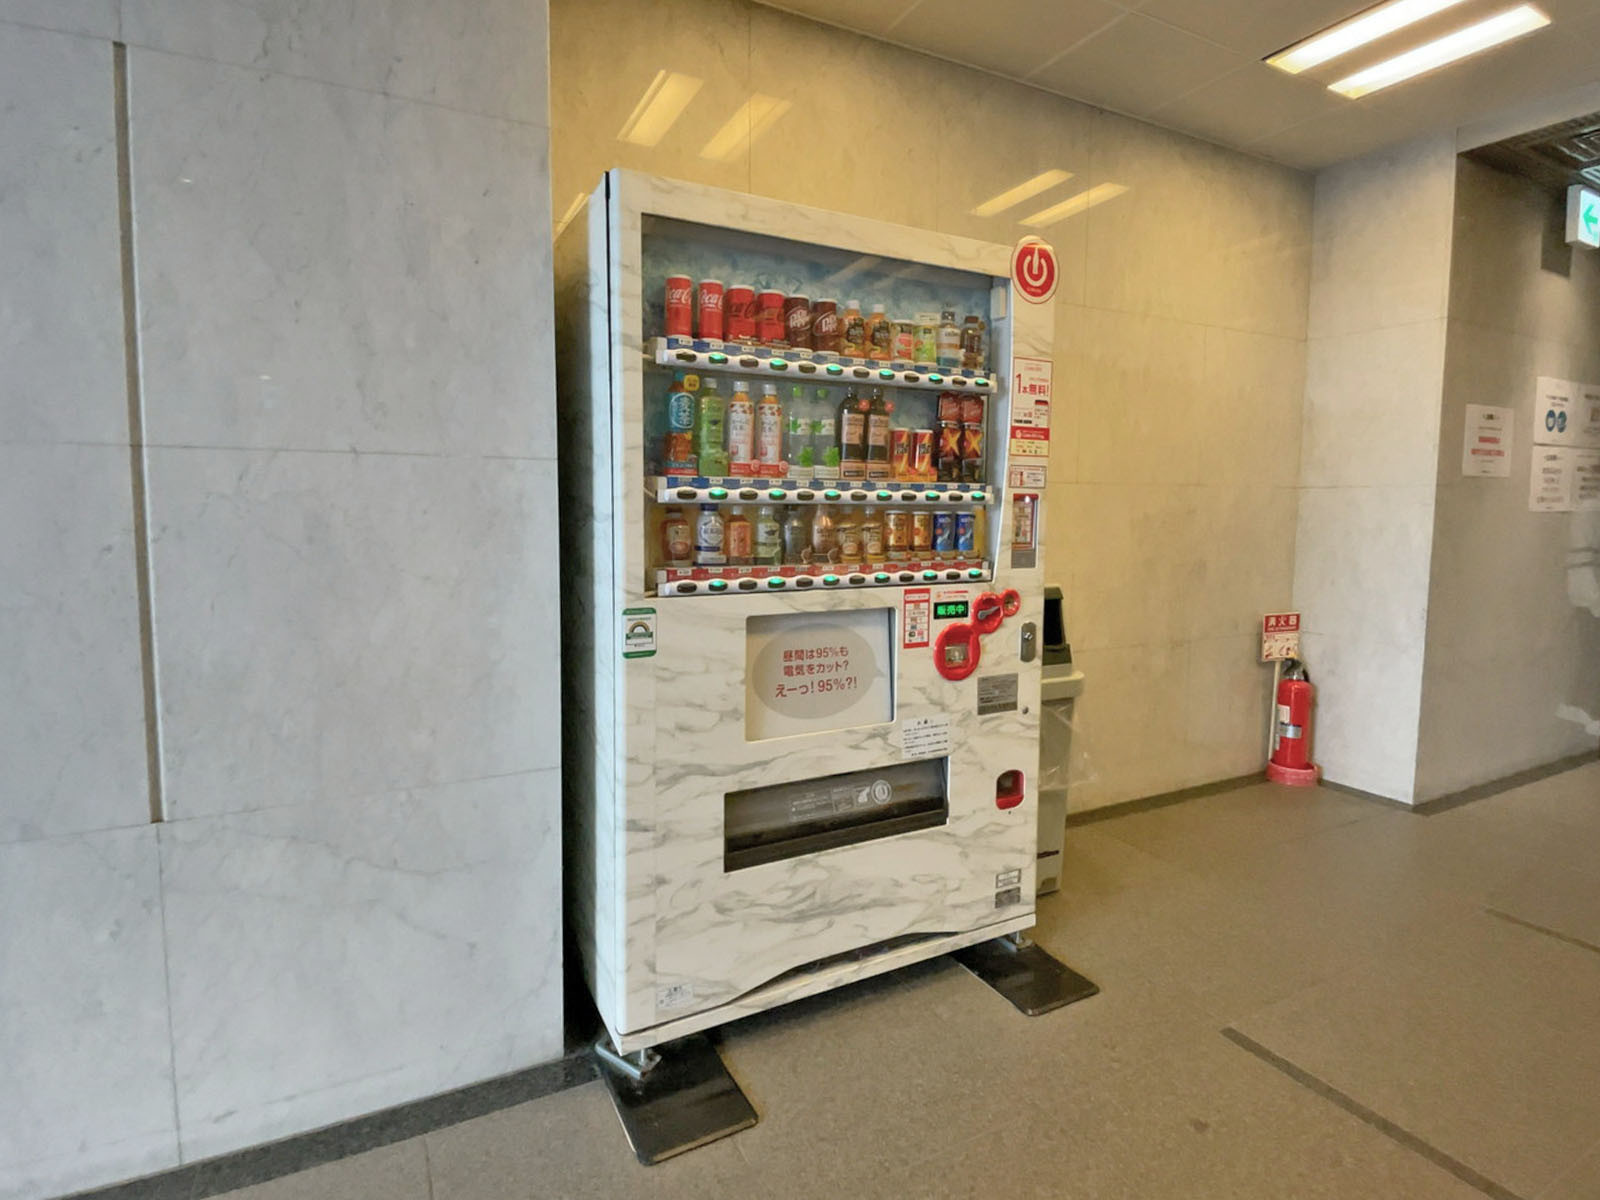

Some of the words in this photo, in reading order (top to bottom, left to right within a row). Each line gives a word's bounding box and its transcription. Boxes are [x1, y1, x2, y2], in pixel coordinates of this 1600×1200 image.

[937, 604, 965, 616] 販売中
[783, 646, 849, 662] 昼間は95%も
[783, 660, 849, 677] 電気をカット?
